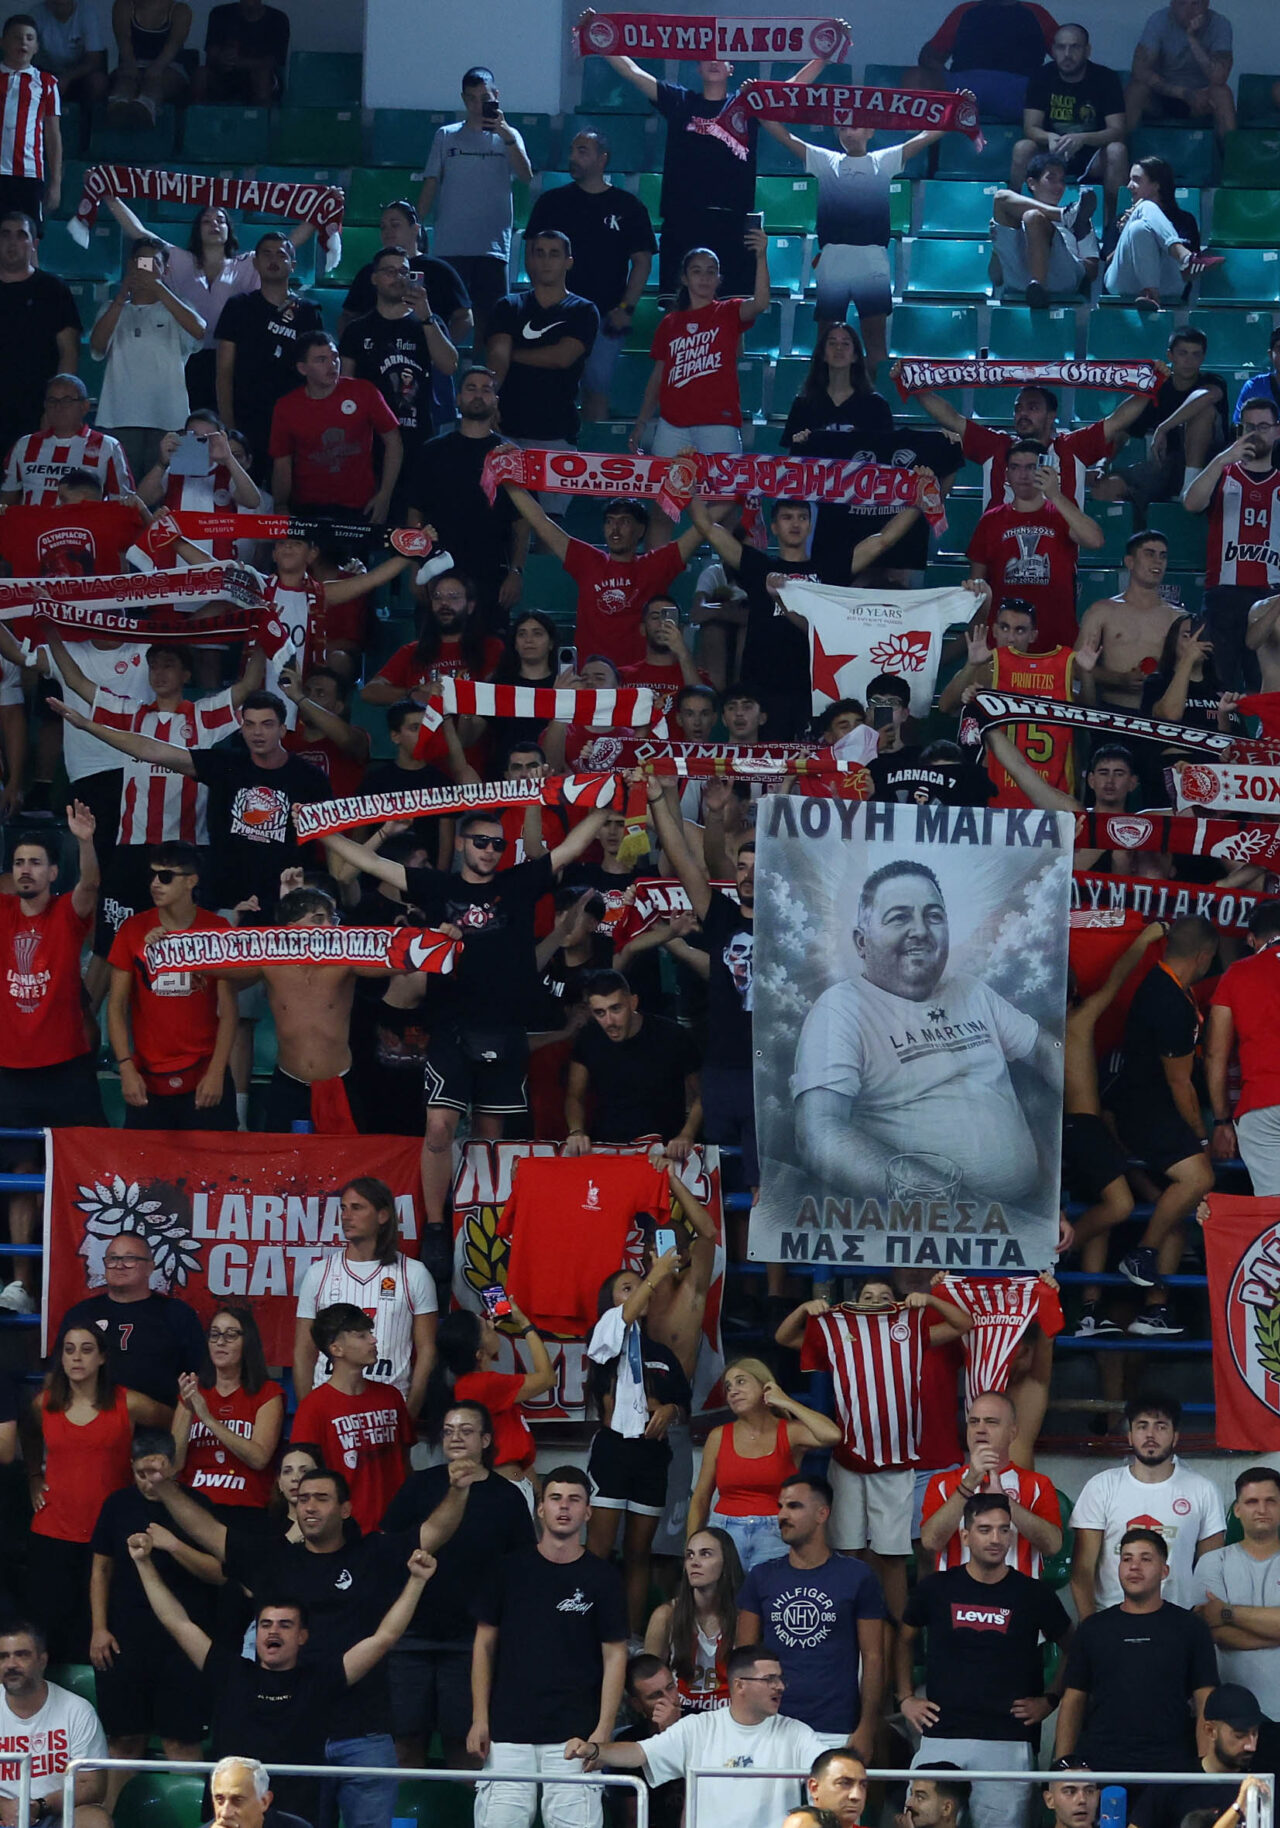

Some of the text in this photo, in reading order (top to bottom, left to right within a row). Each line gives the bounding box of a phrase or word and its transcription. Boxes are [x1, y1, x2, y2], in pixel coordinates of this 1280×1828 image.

[623, 23, 804, 54] OLYMPIAKOS
[746, 86, 946, 124] OLYMPIAKOS
[87, 165, 342, 226] OLYMPIACOS
[668, 326, 721, 358] ΠΑΝΤΟΥ
[675, 342, 712, 367] ΕΙΝΑΙ
[667, 351, 723, 385] ΠΕΙΡΑΙΑΣ
[901, 362, 1156, 389] Nicosia Gate 7
[25, 464, 80, 476] SIEMEN
[559, 478, 654, 493] CHAMPIONS
[1243, 508, 1268, 528] 94
[41, 531, 88, 545] OLYMPIACOS
[268, 528, 306, 536] LEAGUE
[184, 566, 225, 584] FC
[116, 584, 221, 604] SINCE 1925
[1010, 671, 1055, 691] PRINTEZIS
[975, 692, 1235, 750] OLYMPIACOS
[1006, 722, 1054, 763] 15
[887, 771, 958, 788] LARNACA 7
[379, 789, 417, 814] ΣΤΑ
[502, 776, 541, 800] ΜΑΣ
[768, 795, 1062, 849] ΛΟΥΗ ΜΑΓΚΑ
[1071, 877, 1257, 929] ΛΥΜΠΙΑΚΟΣ
[227, 933, 262, 957] ΣΤΑ
[266, 930, 343, 958] ΑΔΕΡΦΙΑ
[348, 933, 388, 957] ΜΑΣ
[9, 983, 41, 999] GATE
[890, 1031, 918, 1050] LA
[921, 1019, 988, 1043] MARTINA
[192, 1192, 418, 1241] LARNAA
[795, 1195, 1014, 1237] ΑΝΑΜΕΣΑ
[779, 1231, 1027, 1267] ΜΑΣ ΠΑΝΤΑ
[971, 1311, 1025, 1327] Stoiximan
[118, 1323, 134, 1351] 7
[331, 1408, 399, 1436] TOGETHER
[338, 1426, 398, 1451] WE FIGHT
[192, 1469, 248, 1490] bwin
[772, 1586, 834, 1611] HILFIGER
[770, 1611, 784, 1622] EST.
[774, 1624, 832, 1649] NEW YORK
[678, 1692, 731, 1711] meridia
[0, 1729, 68, 1754] HIS IS
